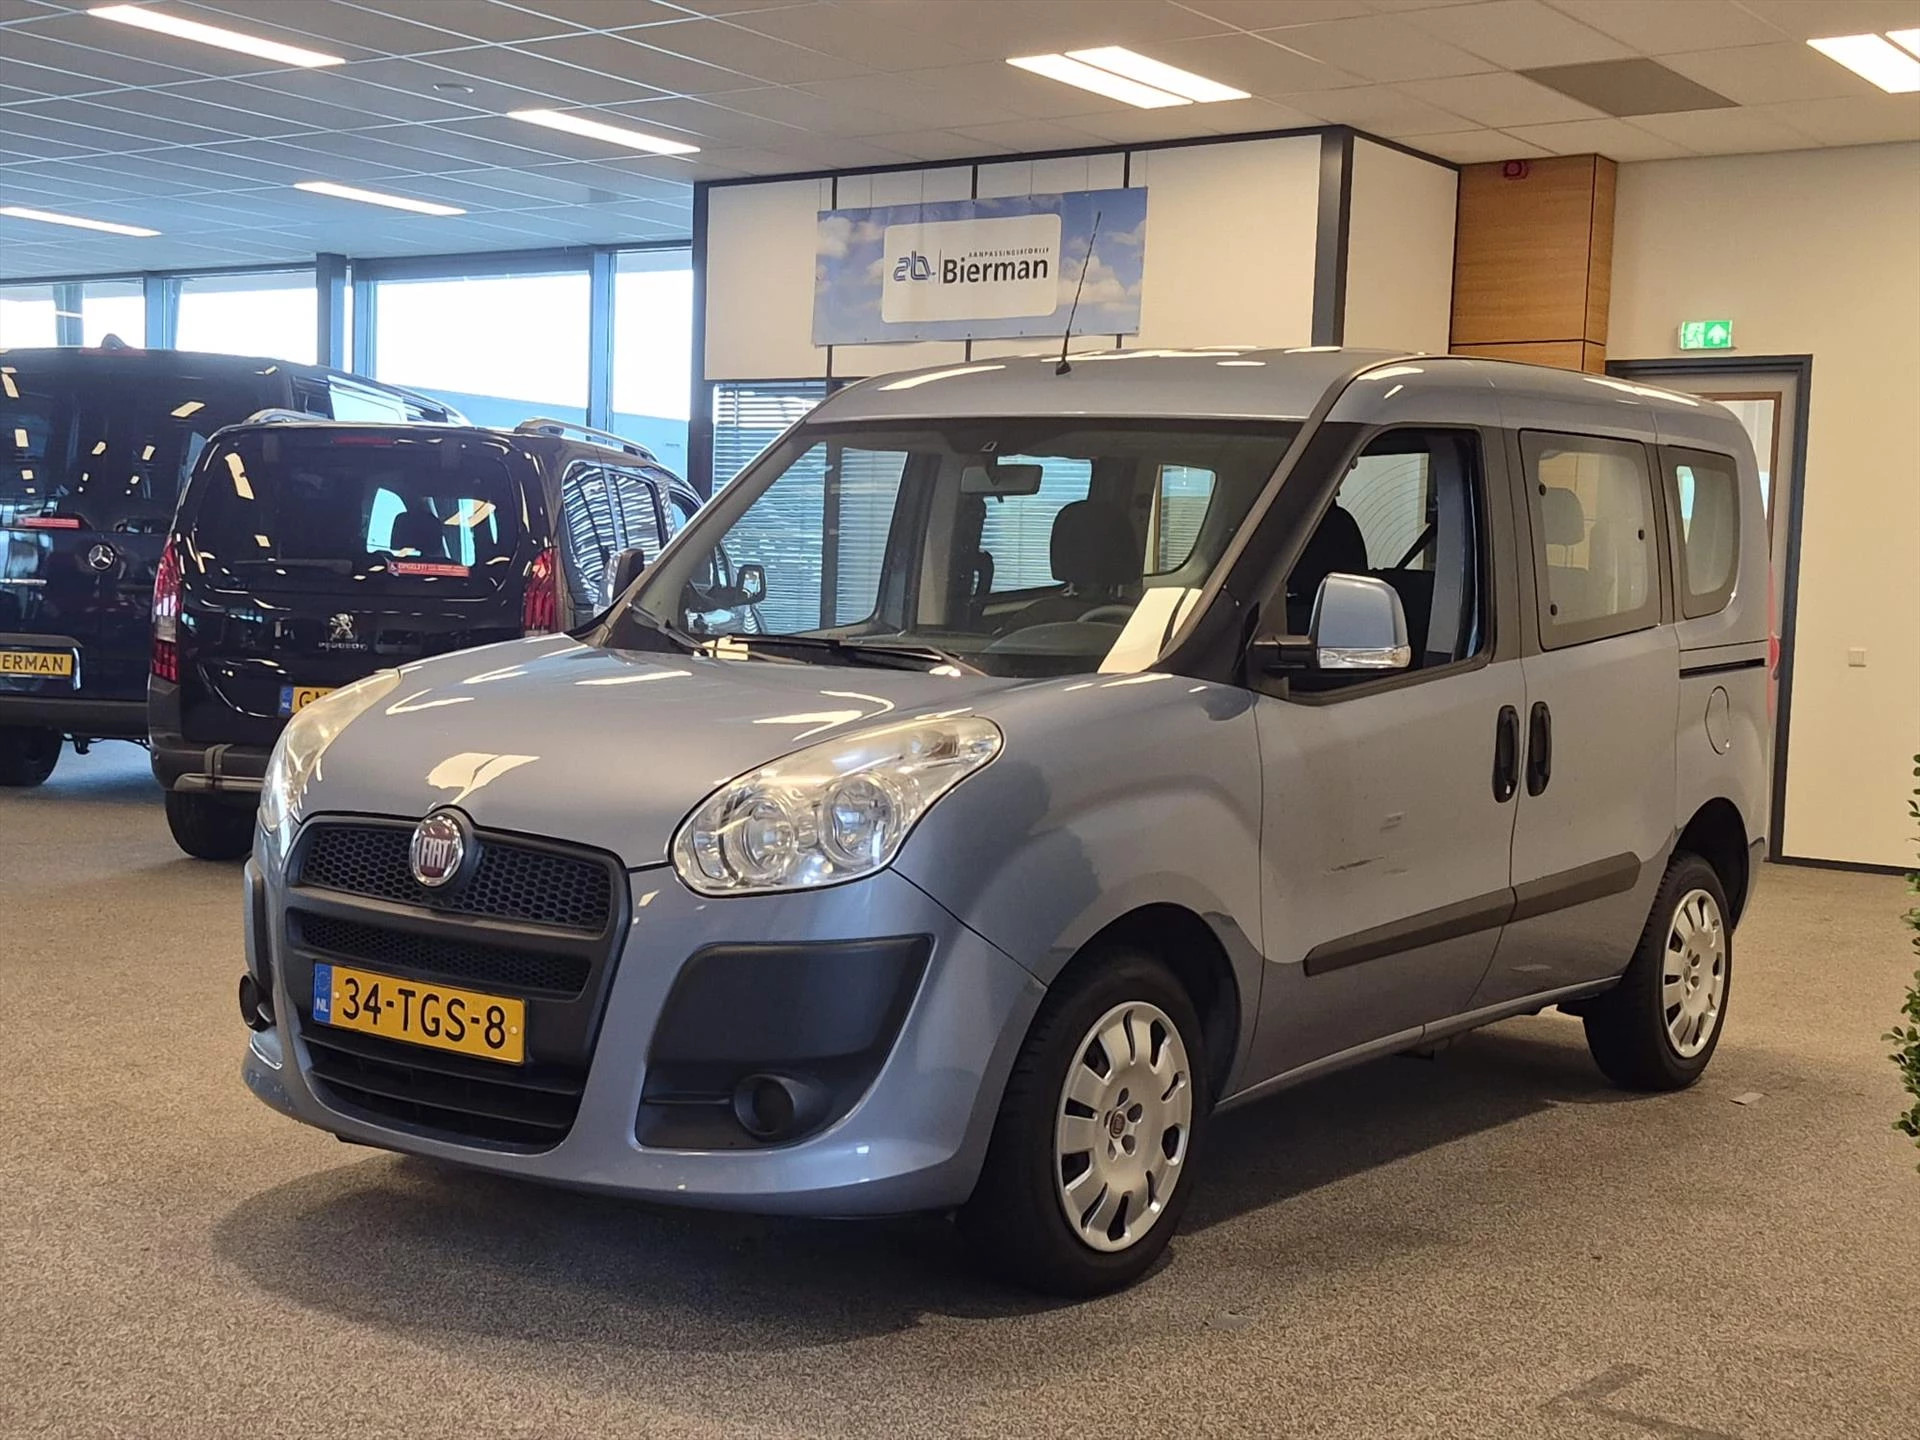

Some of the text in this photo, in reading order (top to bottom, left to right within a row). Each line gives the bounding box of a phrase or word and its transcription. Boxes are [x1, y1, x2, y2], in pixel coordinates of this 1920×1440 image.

[943, 257, 1048, 283] Bierman
[420, 837, 451, 869] FIAT
[316, 997, 329, 1012] NL
[342, 977, 506, 1049] 34-TGS-8
